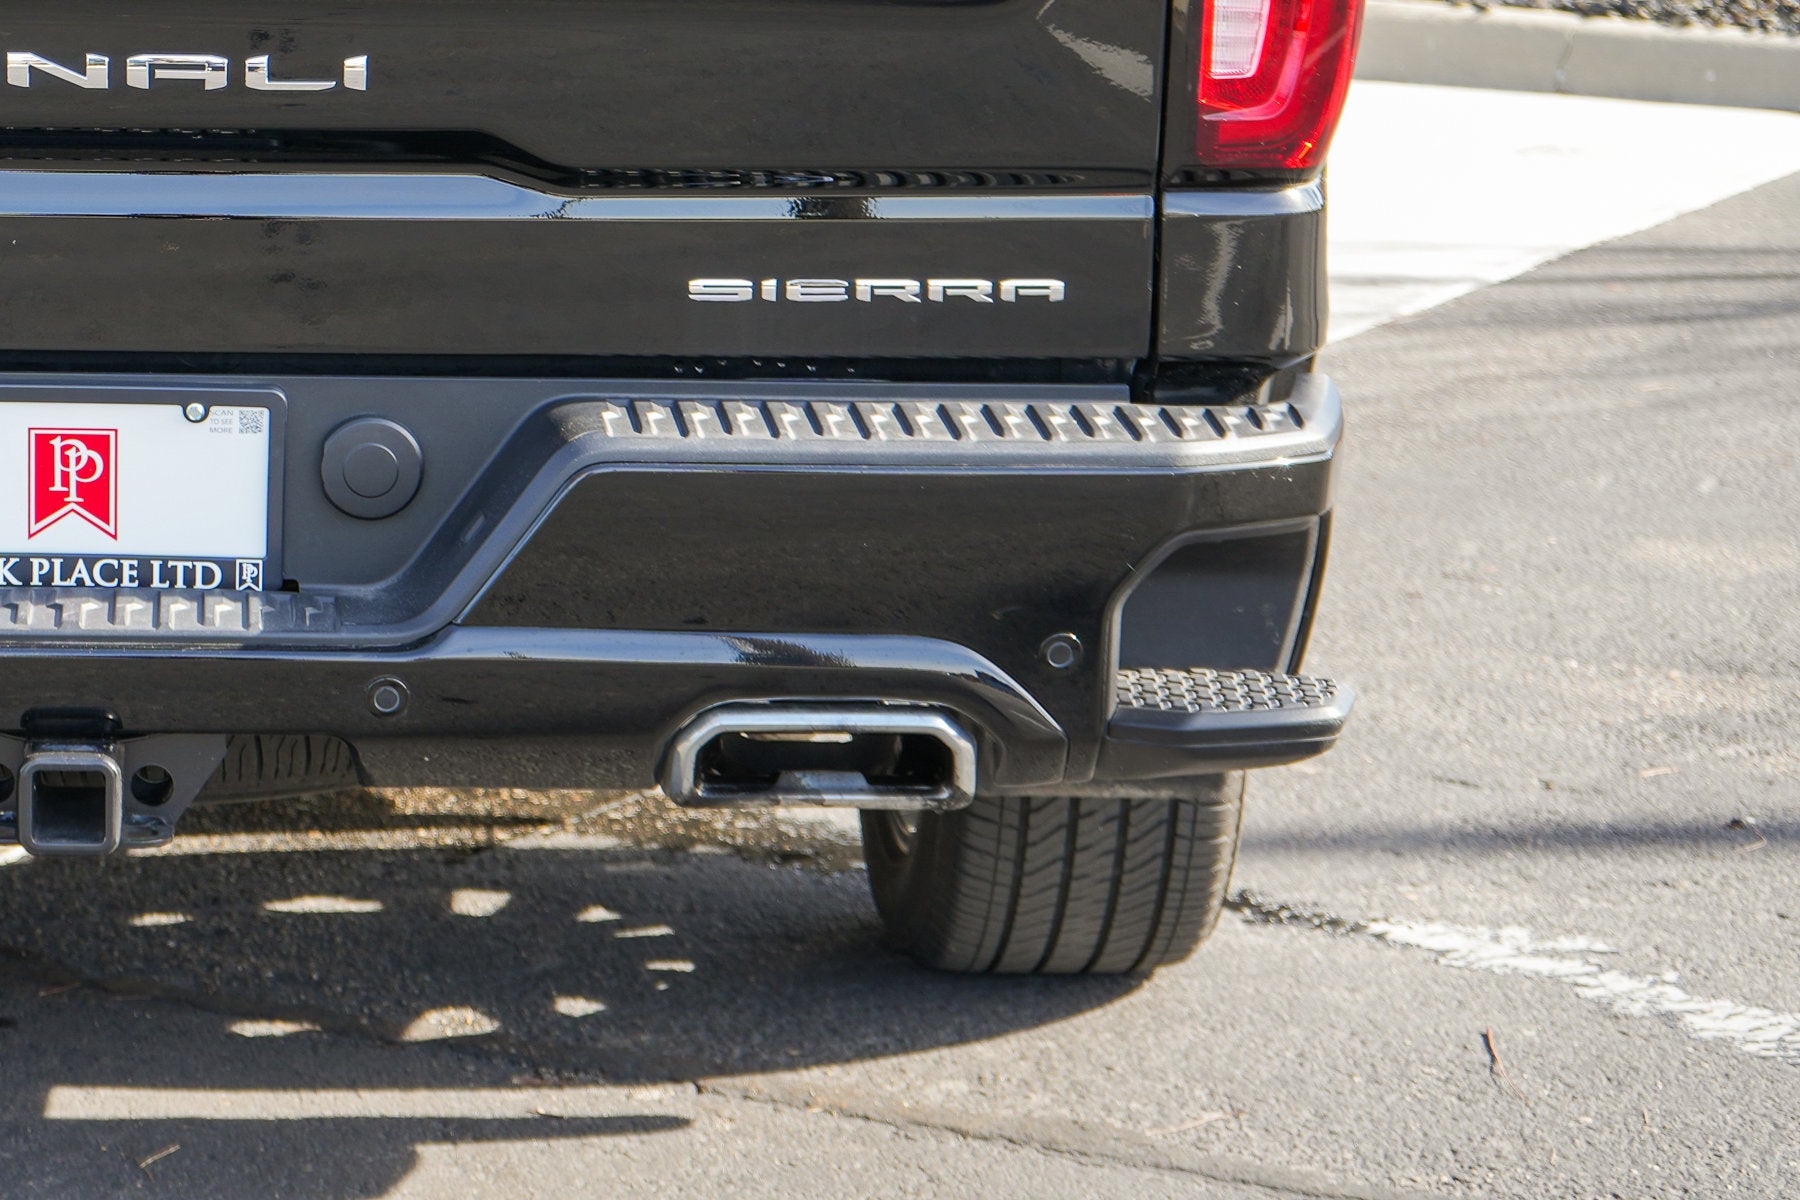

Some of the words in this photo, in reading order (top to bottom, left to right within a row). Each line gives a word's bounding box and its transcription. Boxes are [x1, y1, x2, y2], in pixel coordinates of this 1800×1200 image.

[687, 278, 1066, 303] SIERRA
[29, 556, 140, 588] PLACE
[150, 559, 223, 590] LTD
